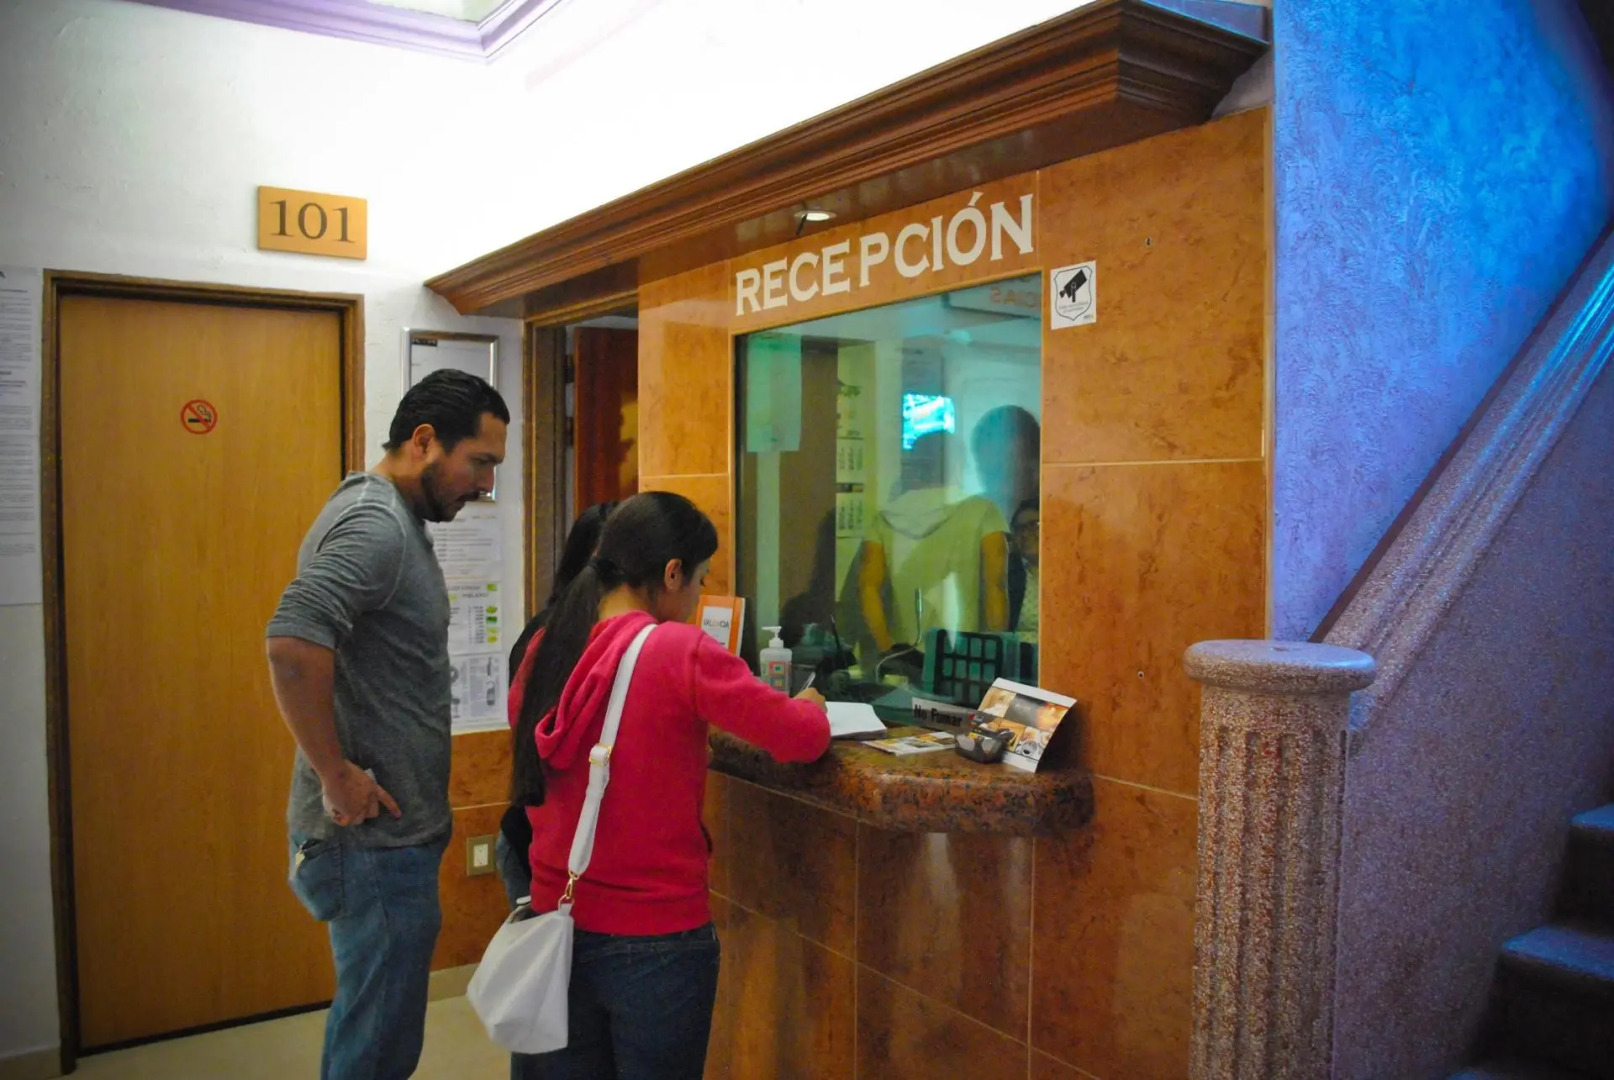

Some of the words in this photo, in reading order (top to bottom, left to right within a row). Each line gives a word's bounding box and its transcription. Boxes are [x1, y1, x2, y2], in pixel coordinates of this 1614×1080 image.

[269, 199, 357, 243] 101
[736, 191, 1033, 316] RECEPCIÓN
[914, 703, 928, 720] No
